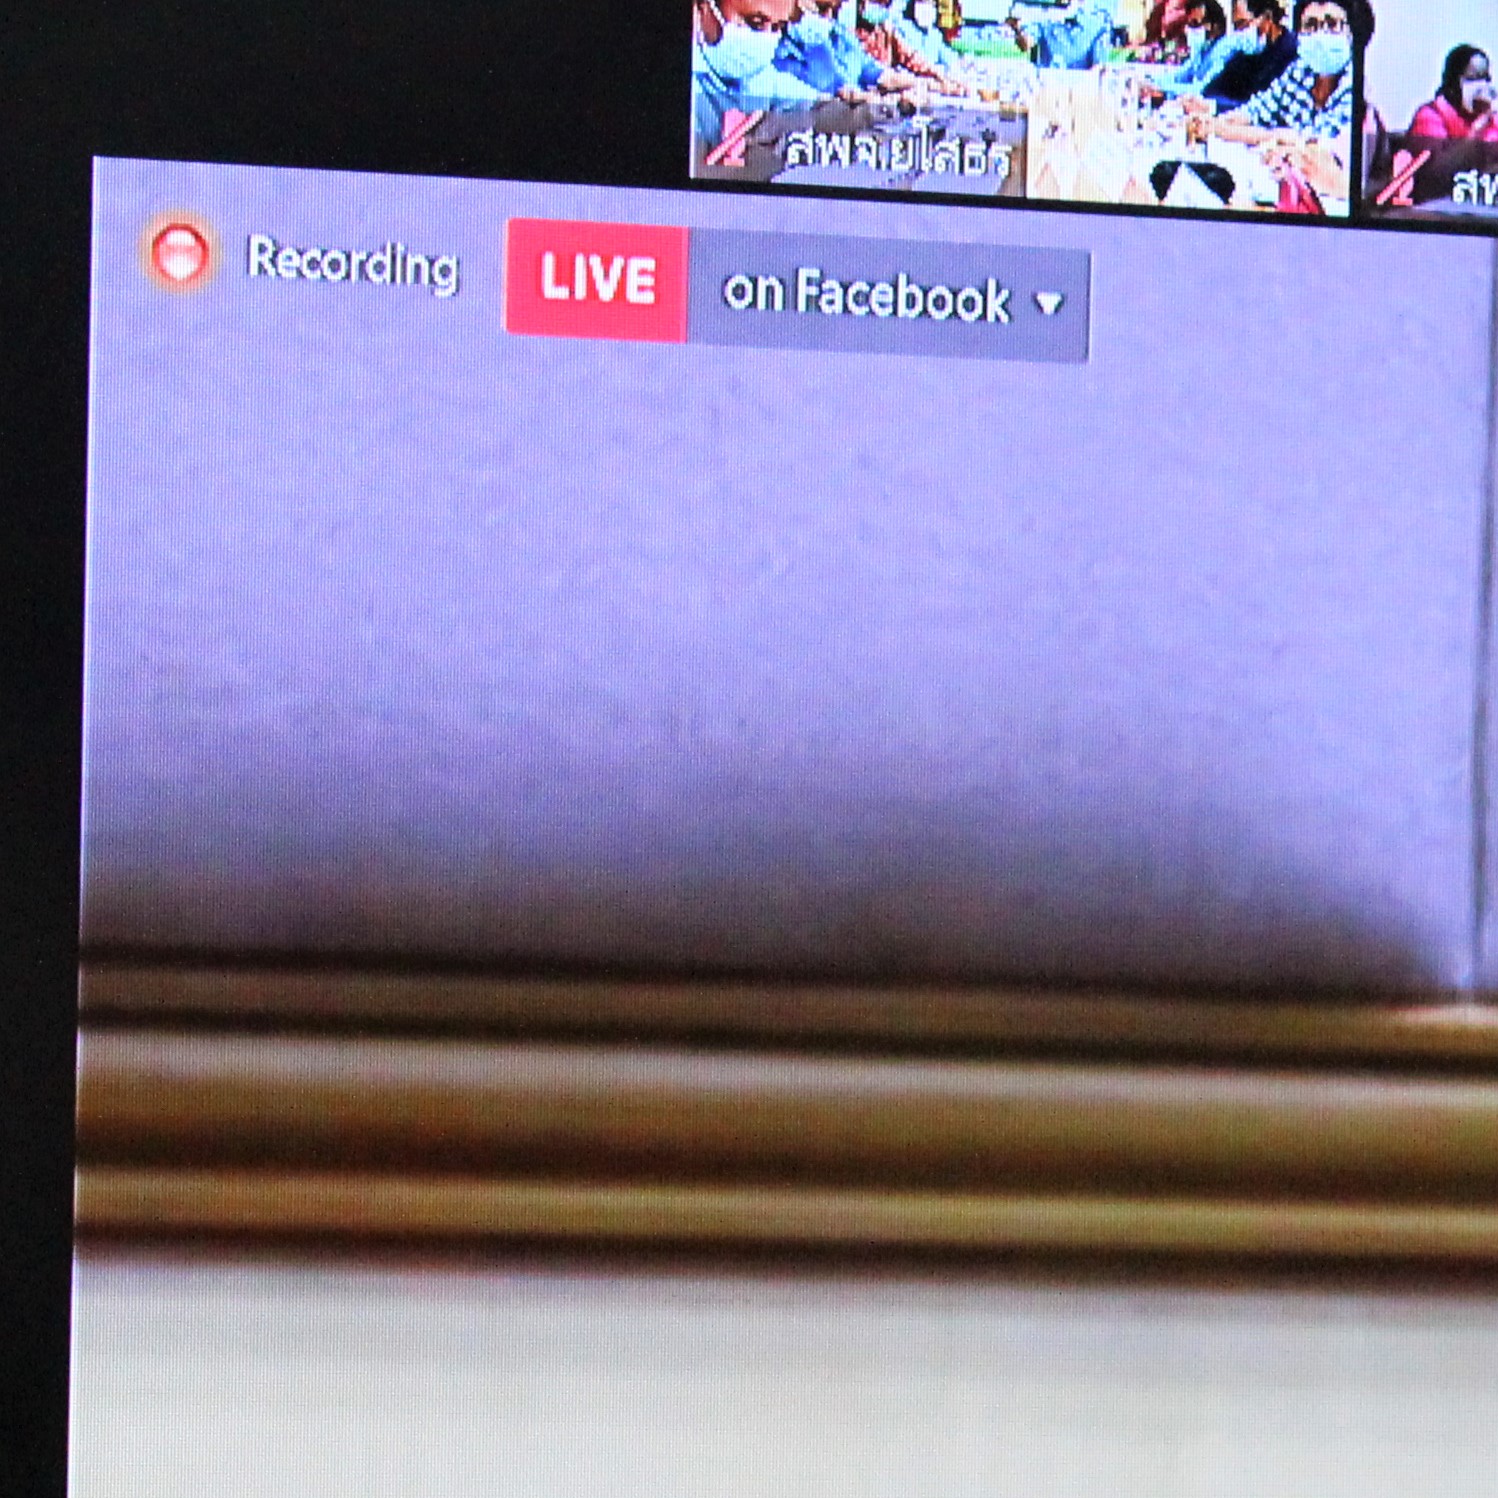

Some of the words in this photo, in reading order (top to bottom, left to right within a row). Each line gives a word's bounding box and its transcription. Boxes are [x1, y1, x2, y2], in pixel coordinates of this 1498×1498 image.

[787, 115, 1012, 178] สพจ.ยโสธร
[248, 232, 461, 298] Recording
[541, 250, 656, 304] LIVE
[724, 273, 785, 312] on
[796, 266, 1012, 325] Facebook
